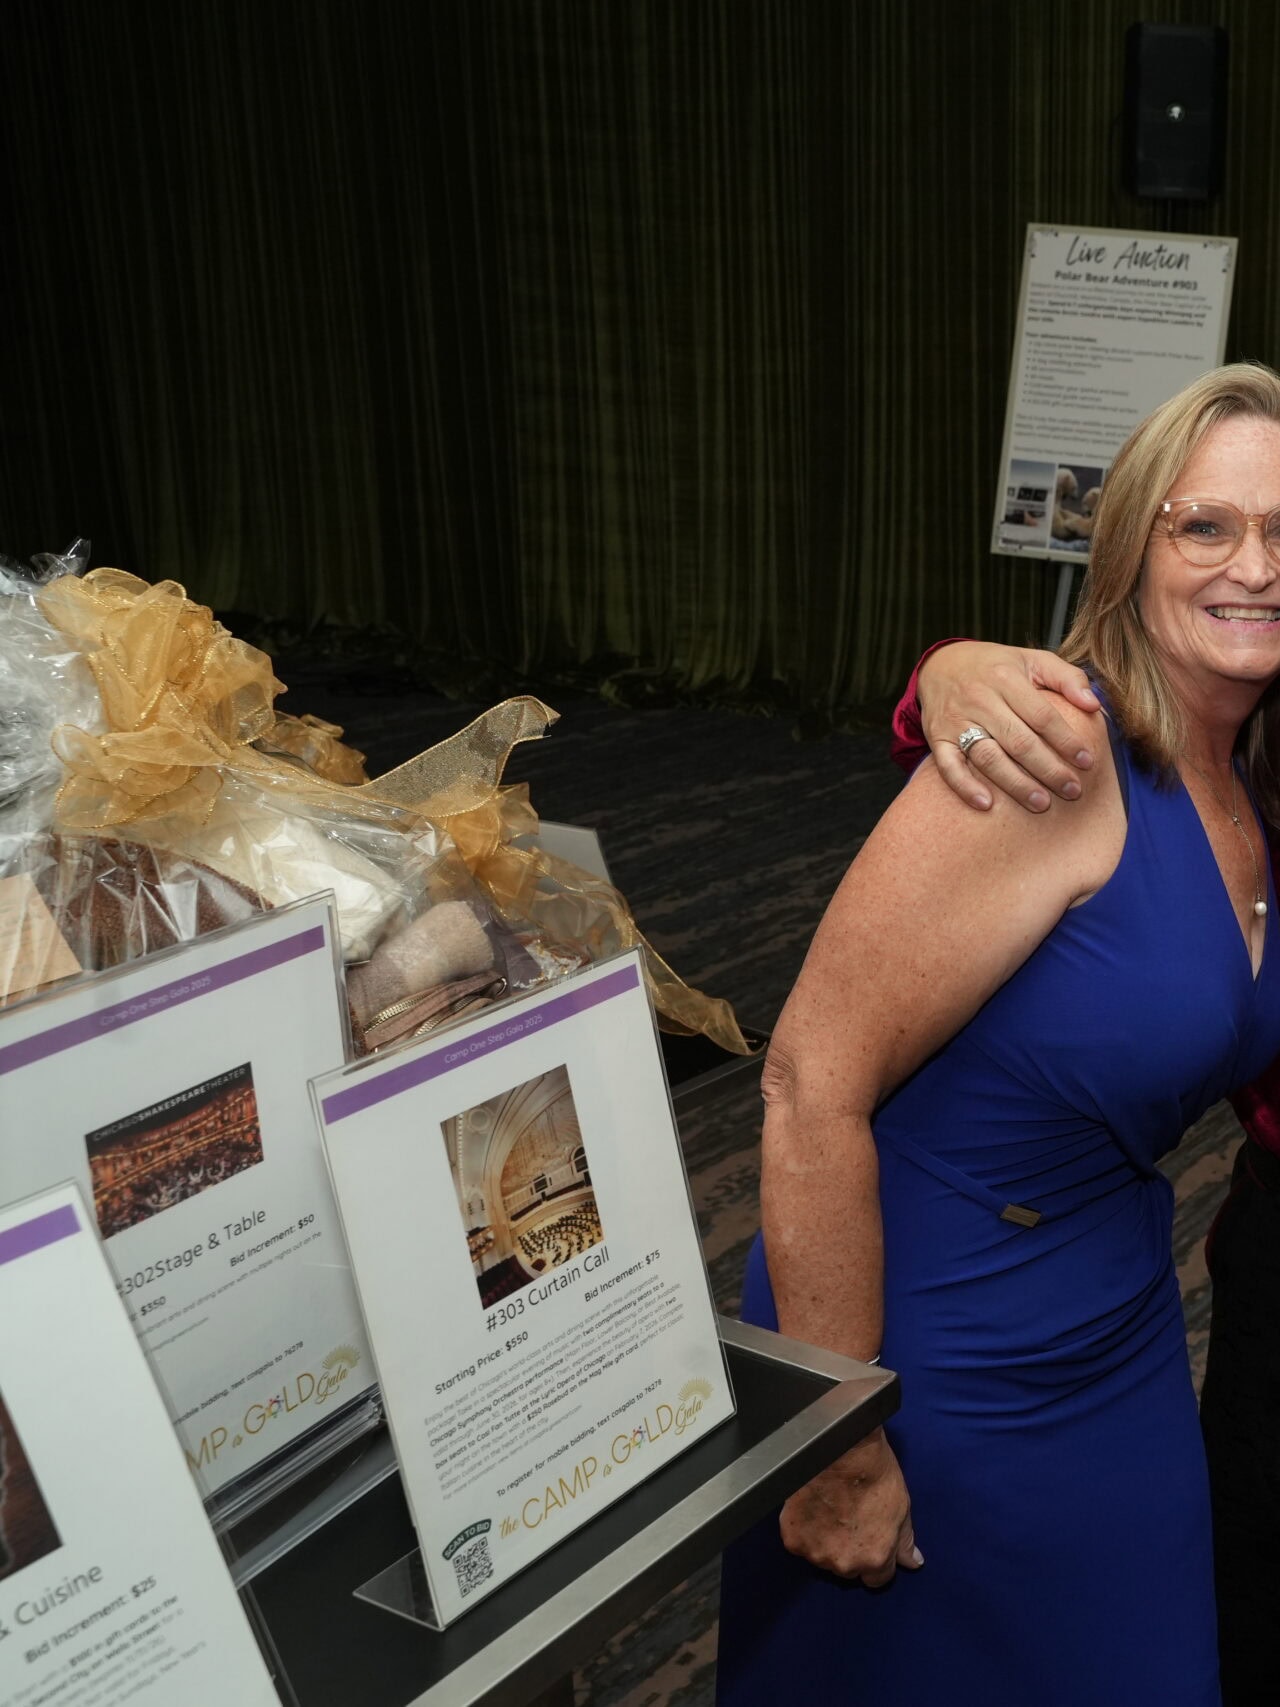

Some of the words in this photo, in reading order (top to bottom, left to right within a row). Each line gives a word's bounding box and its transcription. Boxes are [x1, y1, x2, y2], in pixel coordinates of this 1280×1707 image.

[1066, 234, 1106, 266] Live
[1113, 240, 1190, 271] Auction
[1054, 270, 1082, 281] Polar
[1085, 272, 1109, 283] Bear
[1112, 275, 1169, 288] Adventure
[1172, 280, 1197, 290] #903
[444, 1048, 469, 1063] Camp
[469, 1040, 486, 1052] One
[487, 1032, 505, 1045] Step
[505, 1024, 523, 1036] Gala
[524, 1014, 543, 1028] 2025
[207, 1232, 221, 1250] &
[223, 1209, 267, 1241] Table
[230, 1252, 245, 1267] Bid
[247, 1225, 295, 1257] Increment:
[298, 1214, 314, 1229] $50
[486, 1298, 524, 1332] #303
[528, 1267, 580, 1305] Curtain
[583, 1245, 609, 1272] Call
[584, 1287, 598, 1302] Bid
[599, 1262, 644, 1292] Increment:
[645, 1249, 660, 1265] $75
[665, 1296, 676, 1306] two
[582, 1326, 594, 1336] two
[595, 1299, 637, 1329] complimentary
[637, 1290, 652, 1302] seats
[435, 1365, 476, 1394] Starting
[477, 1348, 503, 1368] Price:
[505, 1331, 528, 1351] $550
[527, 1407, 542, 1421] $250
[542, 1389, 568, 1410] Rosebud
[569, 1384, 577, 1392] on
[578, 1377, 588, 1386] the
[588, 1368, 602, 1379] Mag
[602, 1360, 613, 1370] Mile
[614, 1352, 624, 1364] gift
[430, 1427, 457, 1447] Chicago
[457, 1404, 492, 1429] Symphony
[492, 1383, 524, 1406] Orchestra
[524, 1358, 563, 1387] performance
[435, 1458, 448, 1469] box
[448, 1445, 467, 1460] seats
[467, 1439, 476, 1448] to
[490, 1421, 503, 1432] Fan
[504, 1410, 520, 1422] Tutte
[521, 1404, 529, 1413] at
[529, 1397, 540, 1407] the
[540, 1386, 556, 1400] Lyric
[556, 1374, 575, 1389] Opera
[576, 1367, 582, 1376] of
[583, 1354, 606, 1371] Chicago
[187, 1427, 227, 1470] MP
[496, 1488, 505, 1496] To
[507, 1468, 533, 1490] register
[534, 1460, 545, 1471] for
[546, 1444, 569, 1462] mobile
[570, 1426, 596, 1446] bidding,
[597, 1415, 610, 1427] text
[636, 1392, 643, 1400] to
[644, 1378, 662, 1394] 76278
[520, 1457, 599, 1529] CAMP
[610, 1404, 674, 1466] GOLD
[674, 1399, 705, 1436] Gala
[443, 1537, 466, 1560] SCAN
[465, 1526, 478, 1540] TO
[477, 1520, 492, 1534] BID
[14, 1565, 103, 1626] Cuisine
[24, 1640, 51, 1664] Bid
[52, 1594, 129, 1647] Increment:
[130, 1575, 157, 1599] $25
